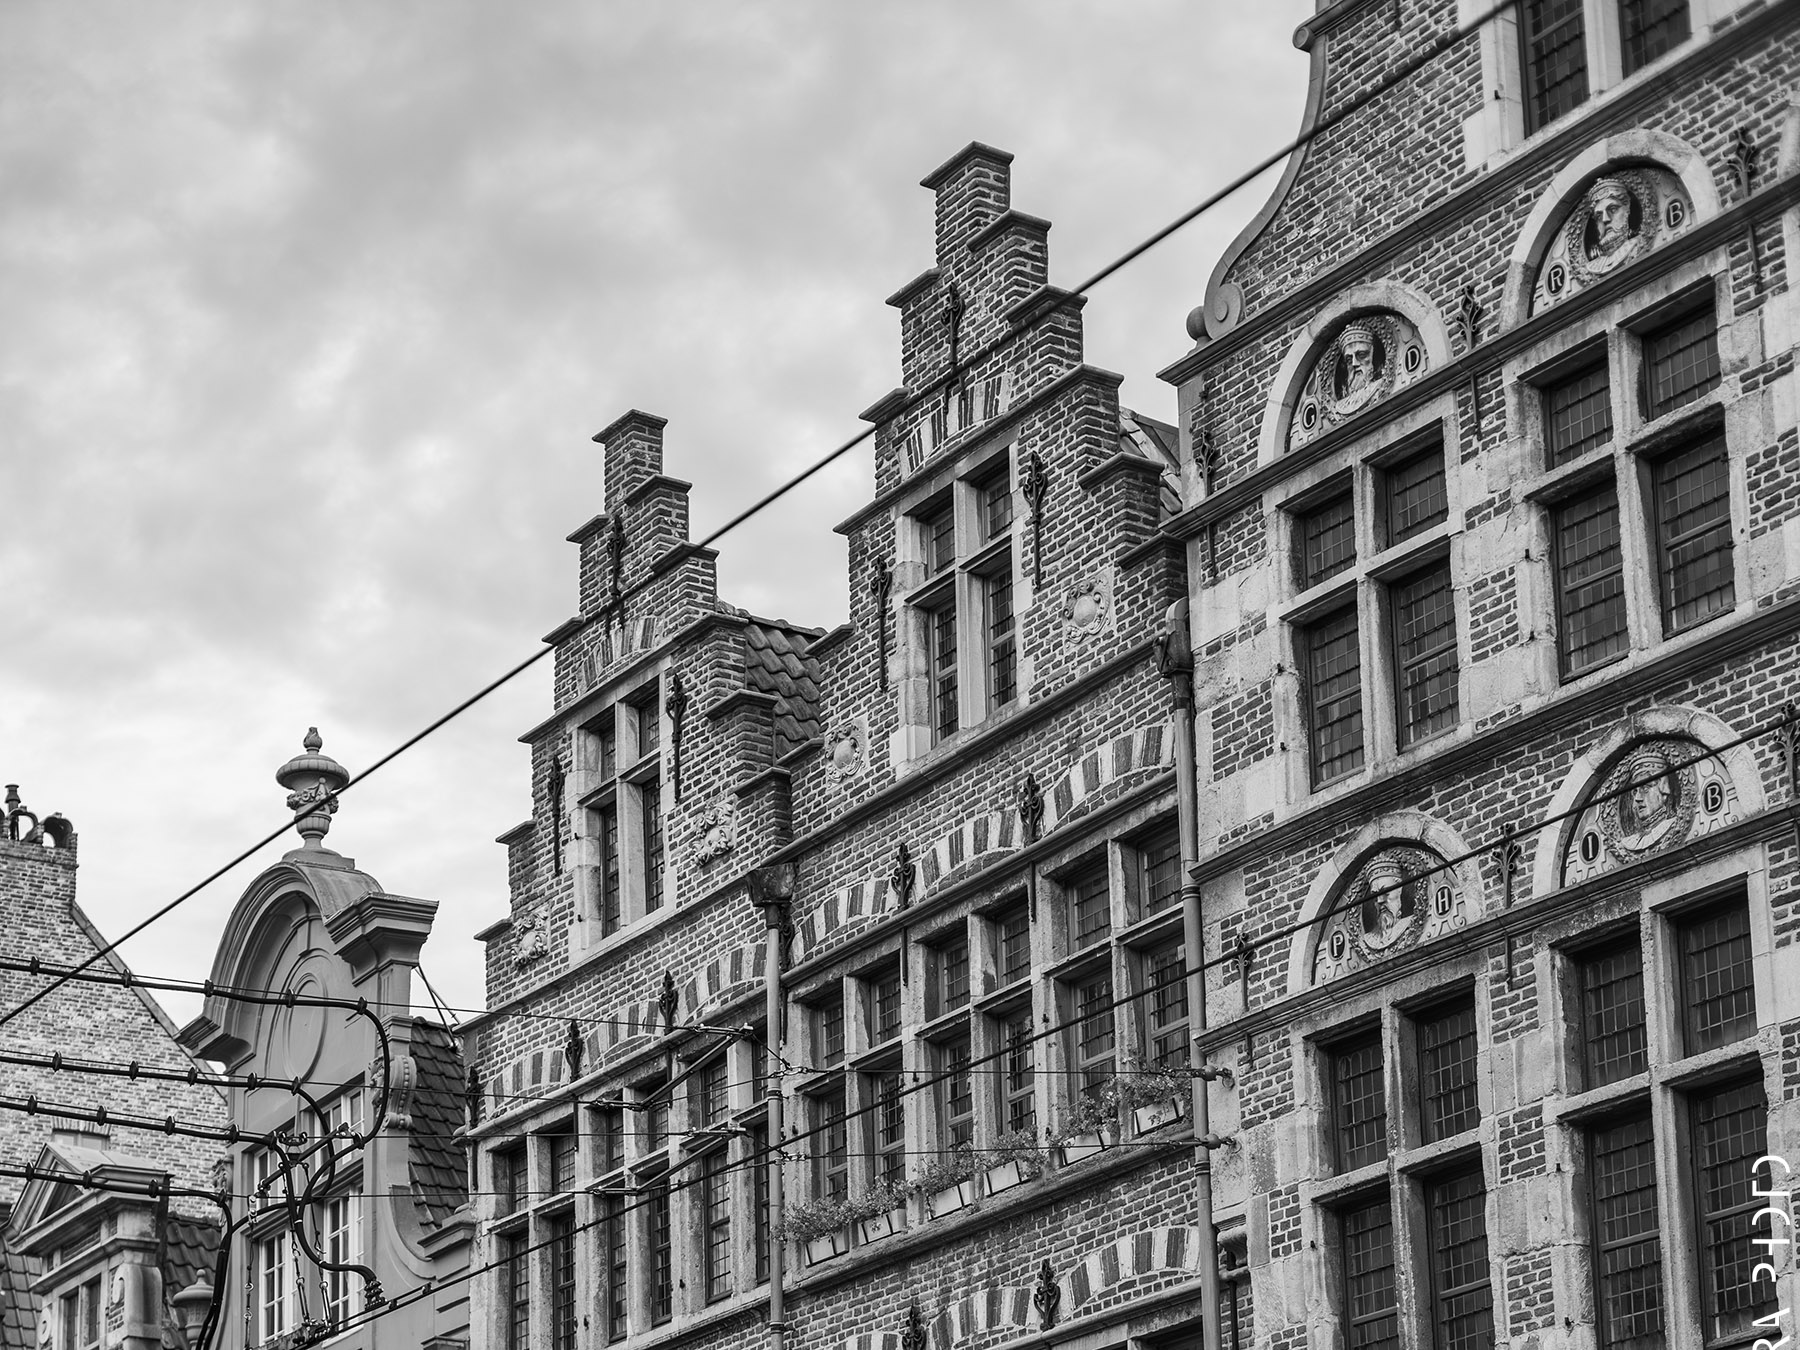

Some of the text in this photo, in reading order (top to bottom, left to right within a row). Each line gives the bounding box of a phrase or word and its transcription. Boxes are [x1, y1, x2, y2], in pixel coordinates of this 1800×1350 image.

[1549, 200, 1683, 293] R B
[1303, 347, 1420, 429] G D
[1706, 785, 1722, 810] B
[1331, 888, 1451, 957] P H
